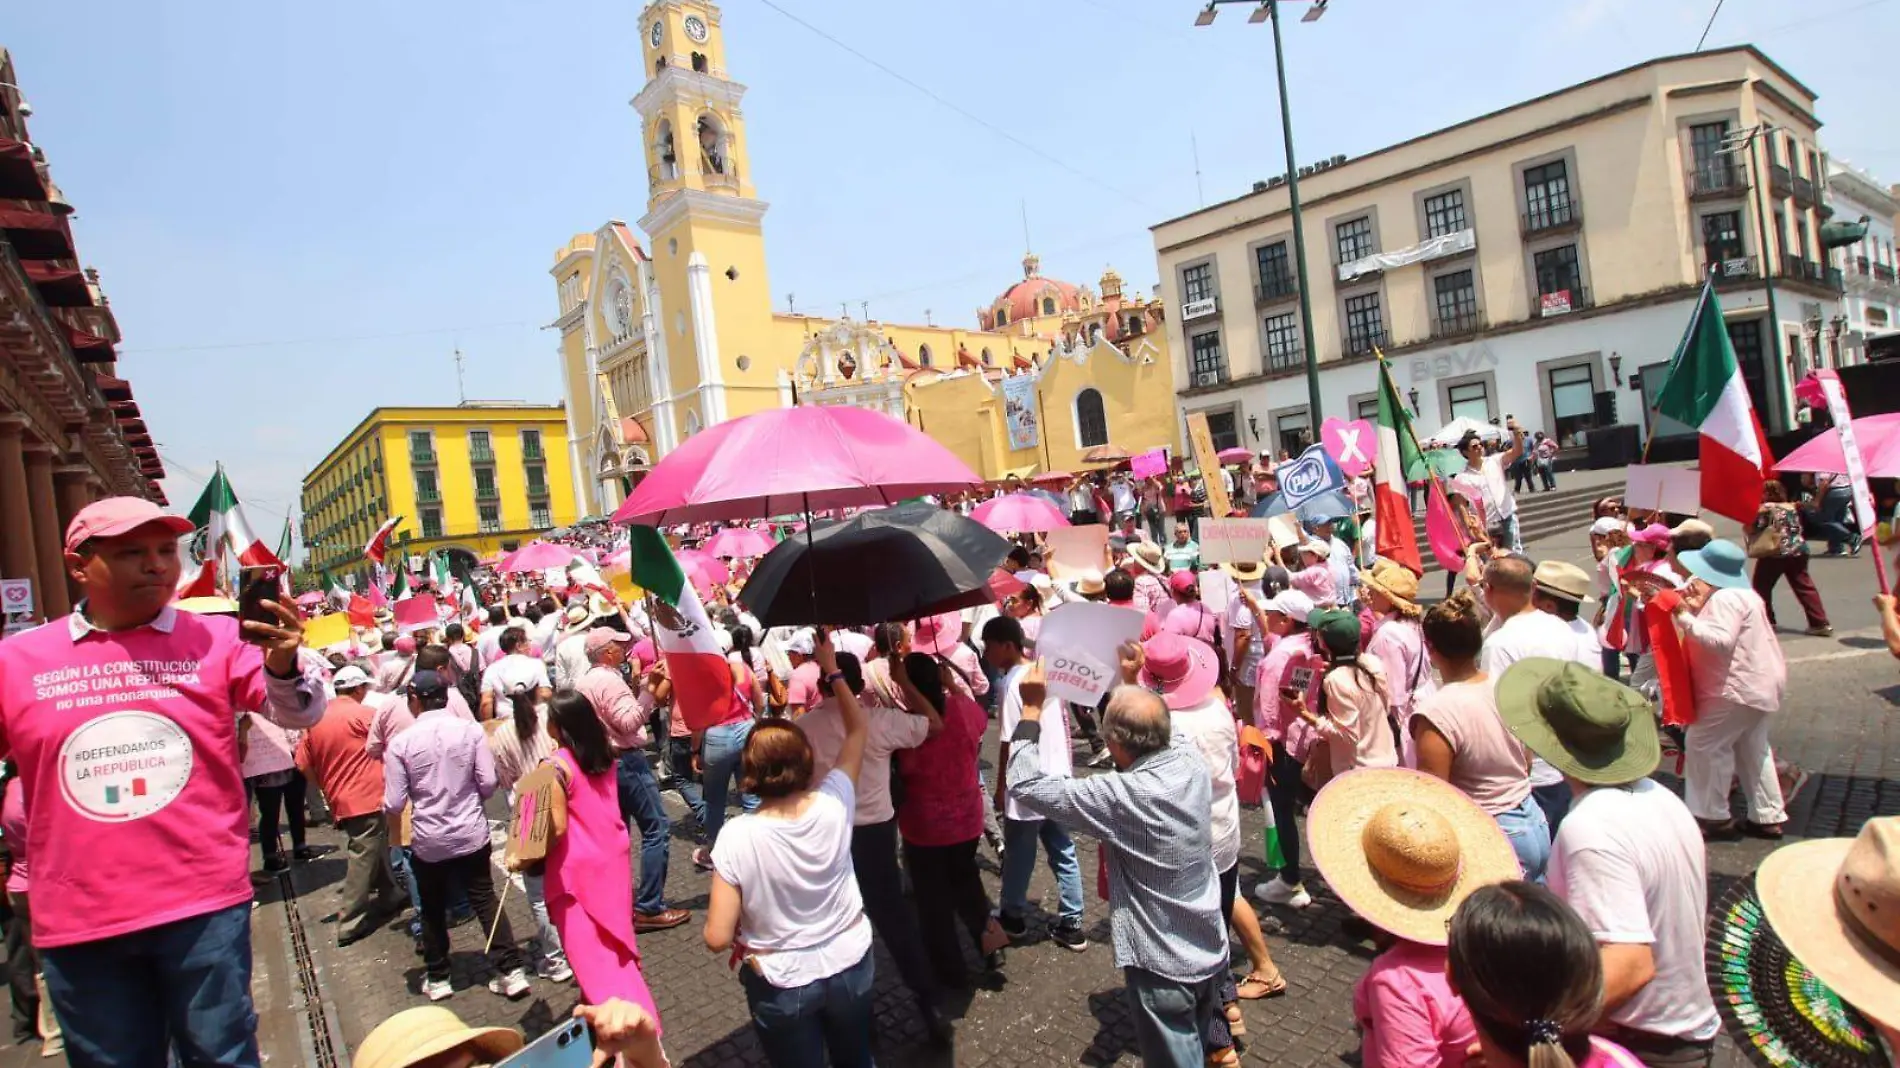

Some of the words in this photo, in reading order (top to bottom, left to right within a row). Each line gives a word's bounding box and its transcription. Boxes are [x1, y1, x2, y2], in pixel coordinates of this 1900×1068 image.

[1290, 462, 1320, 492] PAN
[33, 665, 81, 687] SEGÚN
[83, 664, 101, 677] LA
[103, 658, 201, 675] CONSTITUCIÓN
[35, 679, 88, 700] SOMOS
[92, 677, 123, 690] UNA
[56, 698, 73, 711] no
[76, 693, 103, 707] una
[74, 739, 167, 762] #DEFENDAMOS
[76, 768, 91, 780] LA
